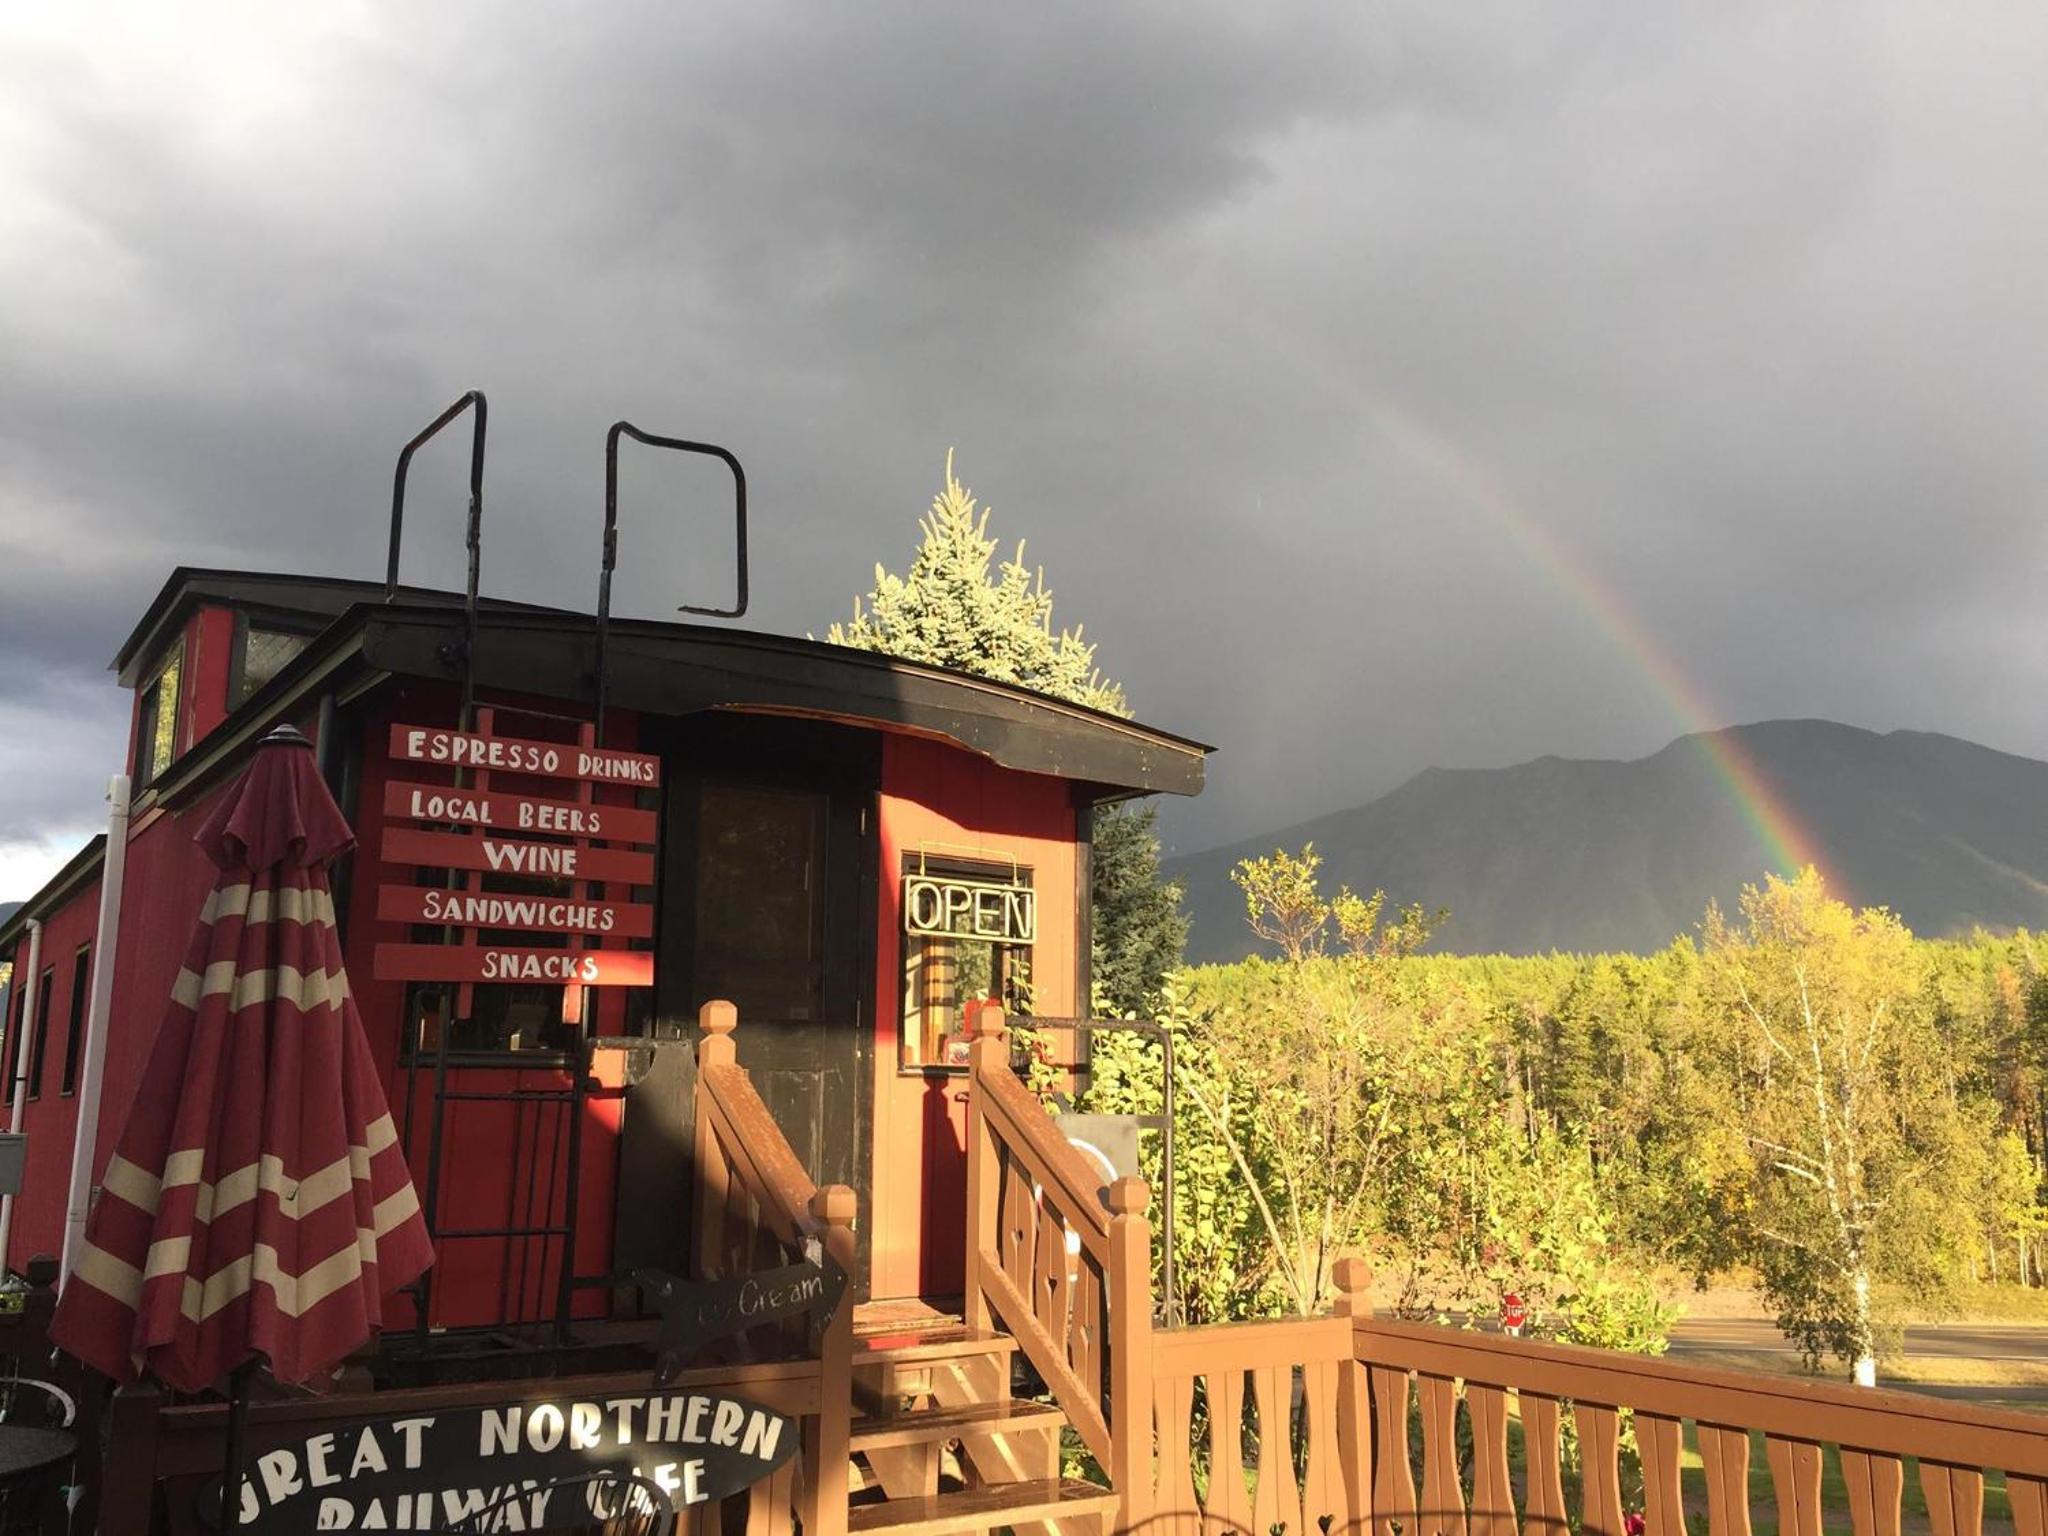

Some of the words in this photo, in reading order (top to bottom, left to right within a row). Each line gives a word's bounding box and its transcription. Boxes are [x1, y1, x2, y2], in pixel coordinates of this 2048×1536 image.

[408, 731, 559, 772] ESPRESSO
[578, 753, 654, 781] DRINKS
[411, 790, 492, 824] LOCAL
[519, 802, 600, 833] BEERS
[482, 841, 576, 875] WINE
[423, 891, 614, 930] SANDWICHES
[910, 882, 1031, 938] OPEN
[481, 952, 599, 980] SNACKS
[738, 1279, 823, 1316] Cream
[1503, 1304, 1525, 1318] TOP
[479, 1396, 784, 1460] NORTHERN
[584, 1458, 708, 1520] CAFE
